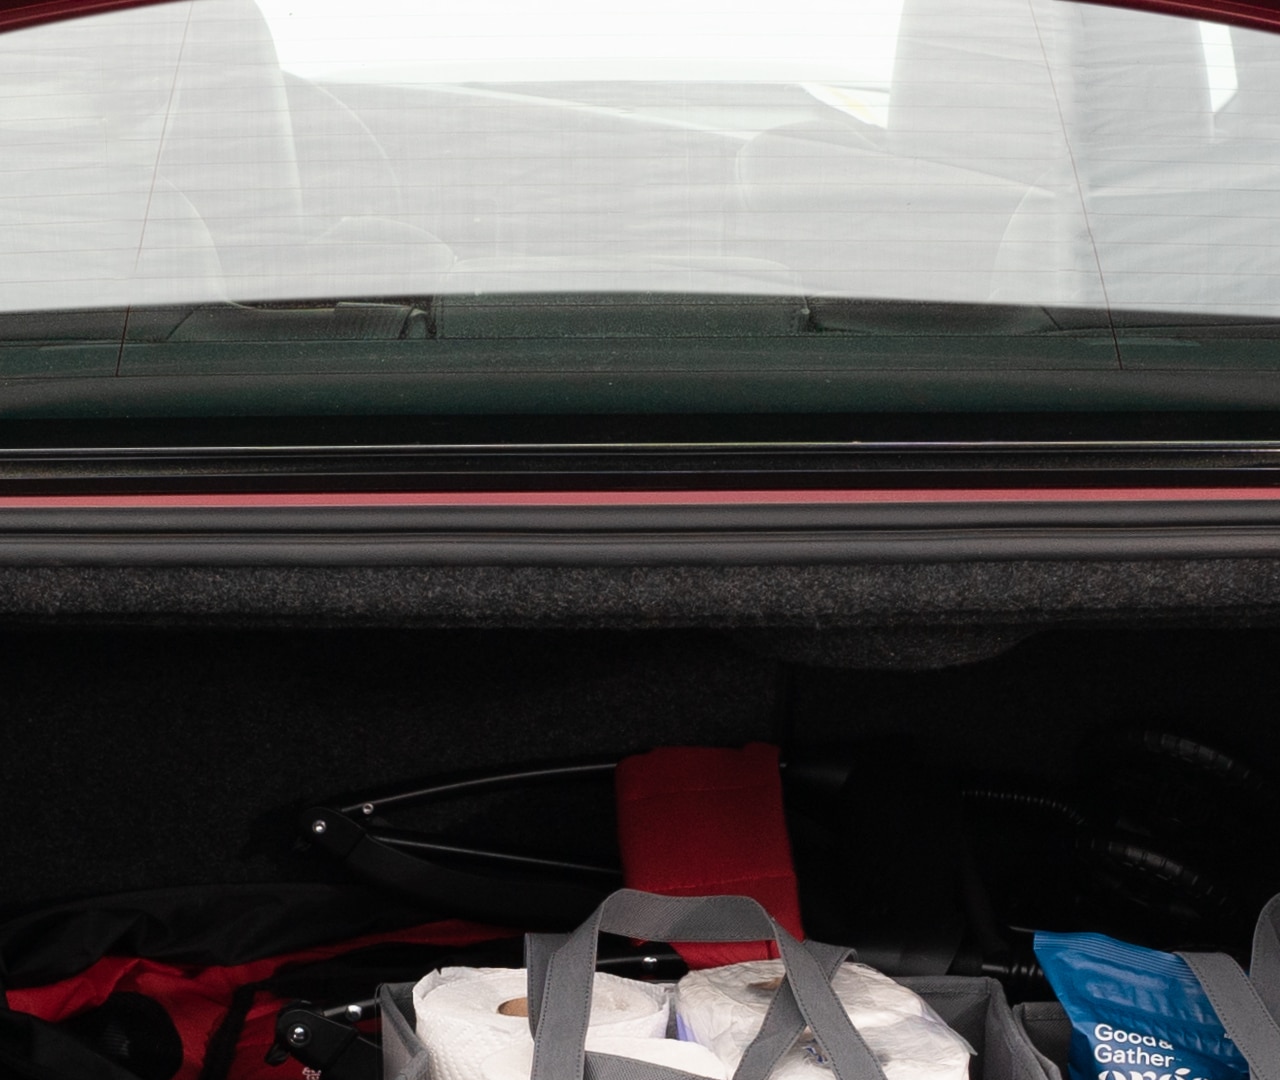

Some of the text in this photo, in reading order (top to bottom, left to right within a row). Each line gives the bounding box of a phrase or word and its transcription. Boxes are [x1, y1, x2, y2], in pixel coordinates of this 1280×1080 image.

[1094, 1023, 1175, 1051] Good &
[1094, 1043, 1175, 1068] Gather
